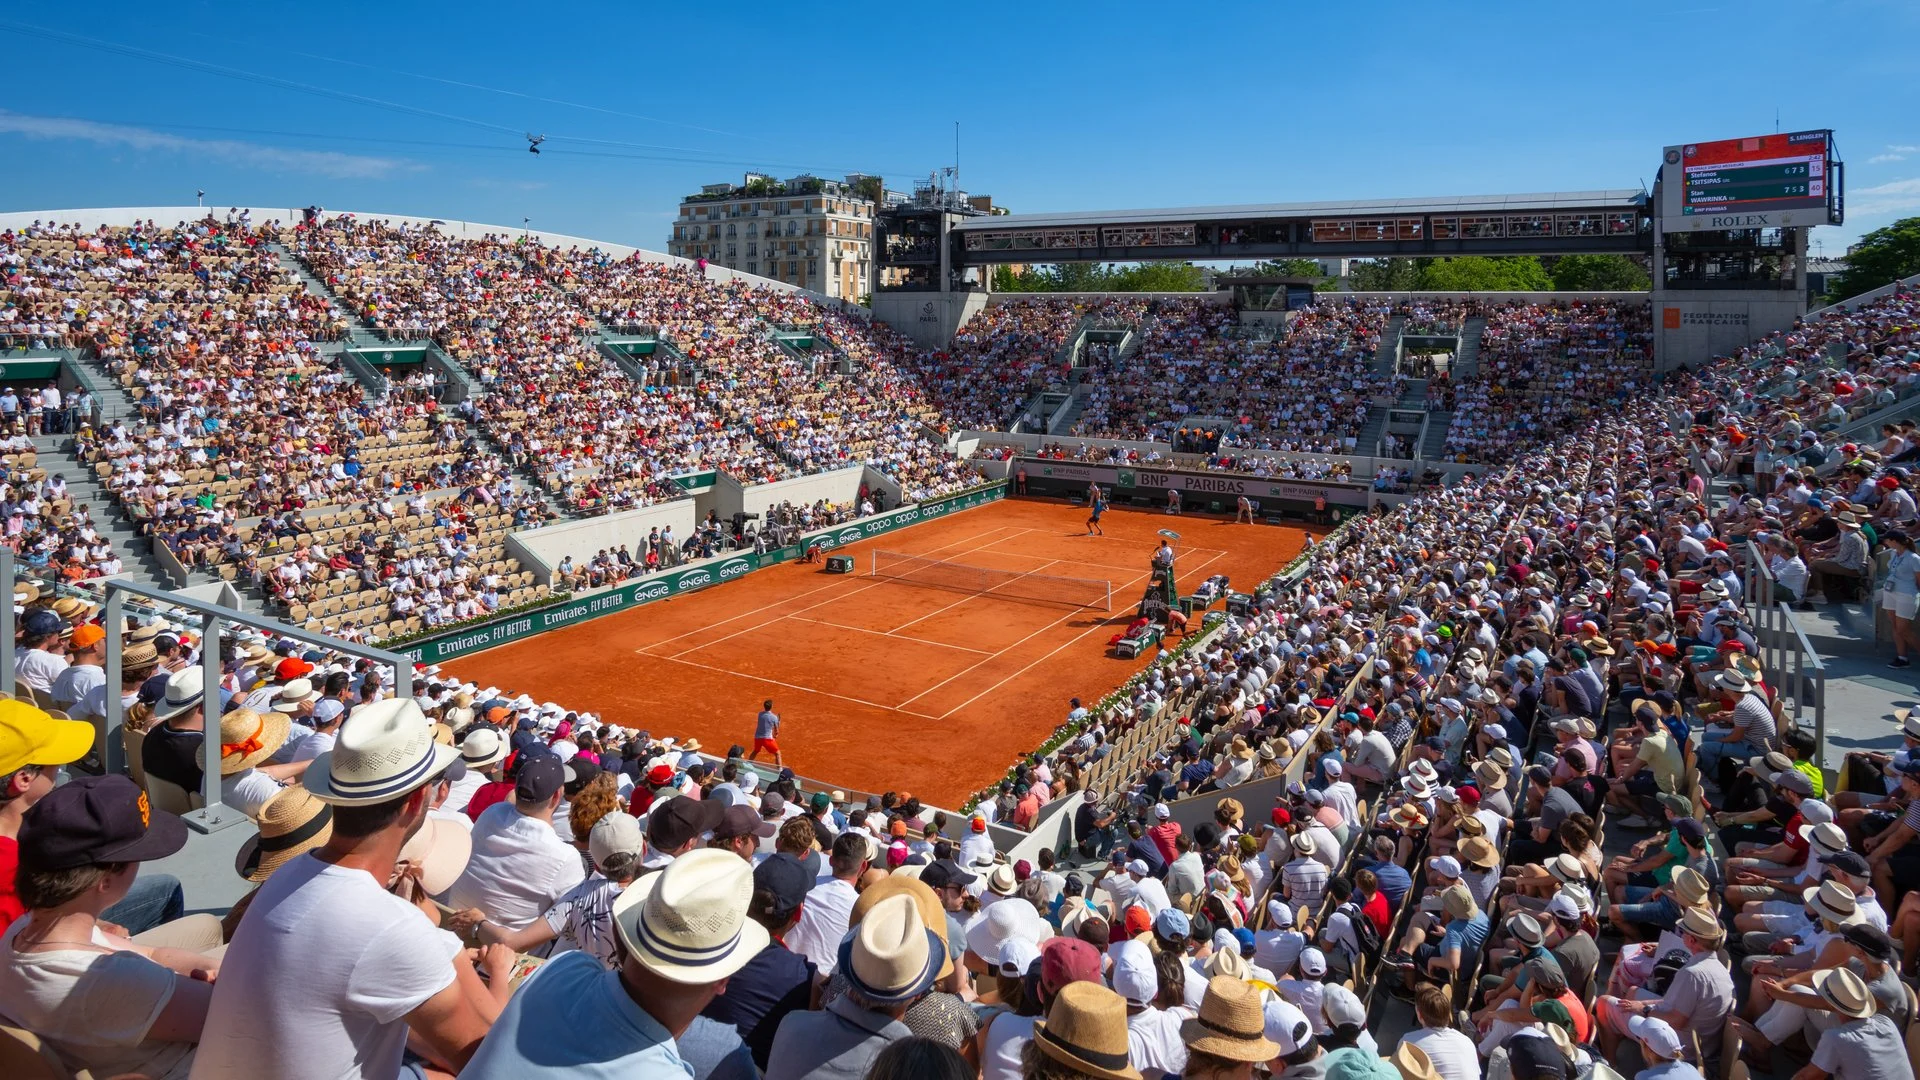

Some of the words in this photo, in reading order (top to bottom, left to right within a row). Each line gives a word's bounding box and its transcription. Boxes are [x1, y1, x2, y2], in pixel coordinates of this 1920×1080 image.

[1796, 133, 1823, 141] LENGLEN
[1691, 178, 1721, 186] TSITSIPAS
[1691, 195, 1727, 204] WAWRINKA
[1712, 215, 1768, 227] ROLEX
[1141, 474, 1168, 486] BNP
[1185, 477, 1244, 493] PARIBAS
[1298, 488, 1328, 496] PARIBAS
[922, 504, 944, 517] oppo
[896, 511, 918, 524] oppo
[866, 519, 891, 533] oppo
[544, 604, 587, 625] Emirates
[590, 600, 601, 612] FLY
[602, 593, 623, 609] BETTER
[437, 632, 489, 655] Emirates
[493, 627, 505, 640] FLY
[506, 619, 531, 638] BETTER
